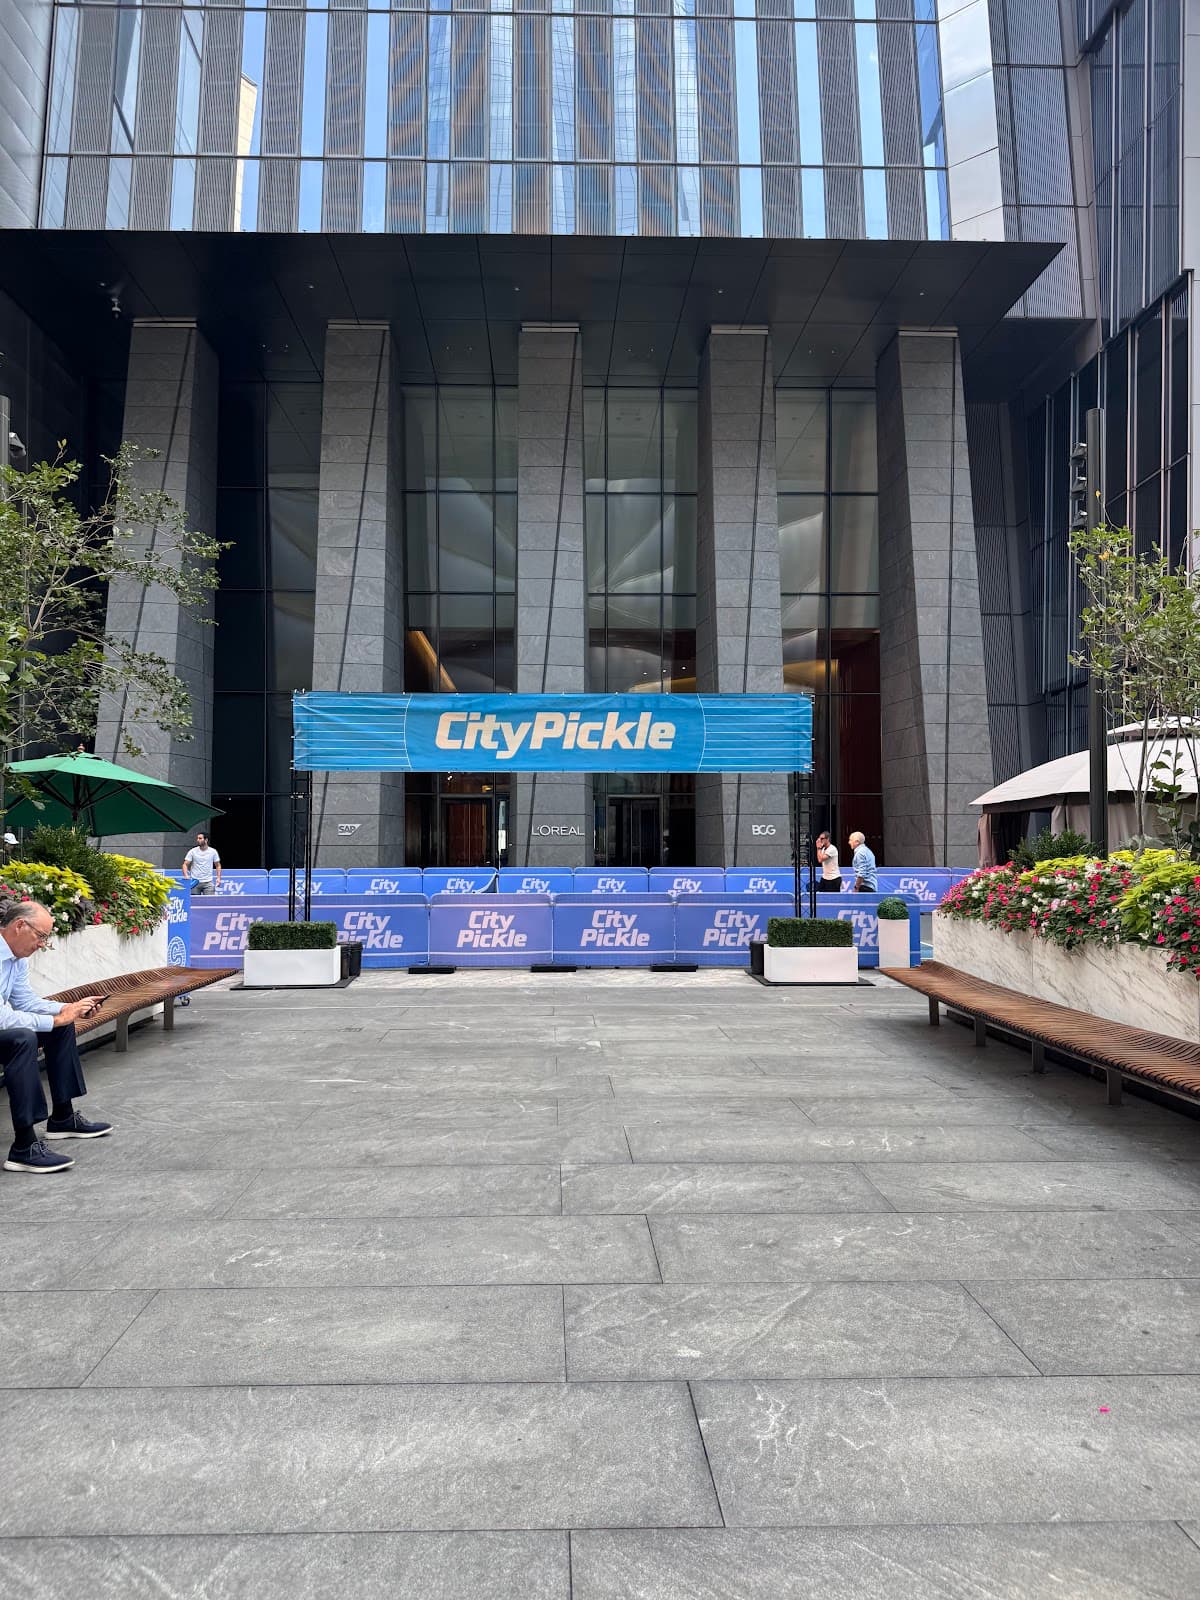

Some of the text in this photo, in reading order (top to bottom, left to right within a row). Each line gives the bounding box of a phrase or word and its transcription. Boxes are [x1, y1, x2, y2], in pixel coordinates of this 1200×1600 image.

[435, 711, 676, 759] CityPickle
[752, 825, 776, 835] BCG
[371, 879, 399, 892] City
[446, 878, 475, 892] City
[522, 878, 550, 891] City
[597, 878, 625, 891] City
[673, 878, 701, 891] City
[748, 878, 776, 891] City
[899, 878, 928, 891] City
[344, 911, 391, 934] City
[468, 910, 515, 933] City
[592, 909, 637, 932] City
[714, 909, 760, 932] City
[456, 928, 527, 947] Pickle
[580, 928, 650, 946] Pickle
